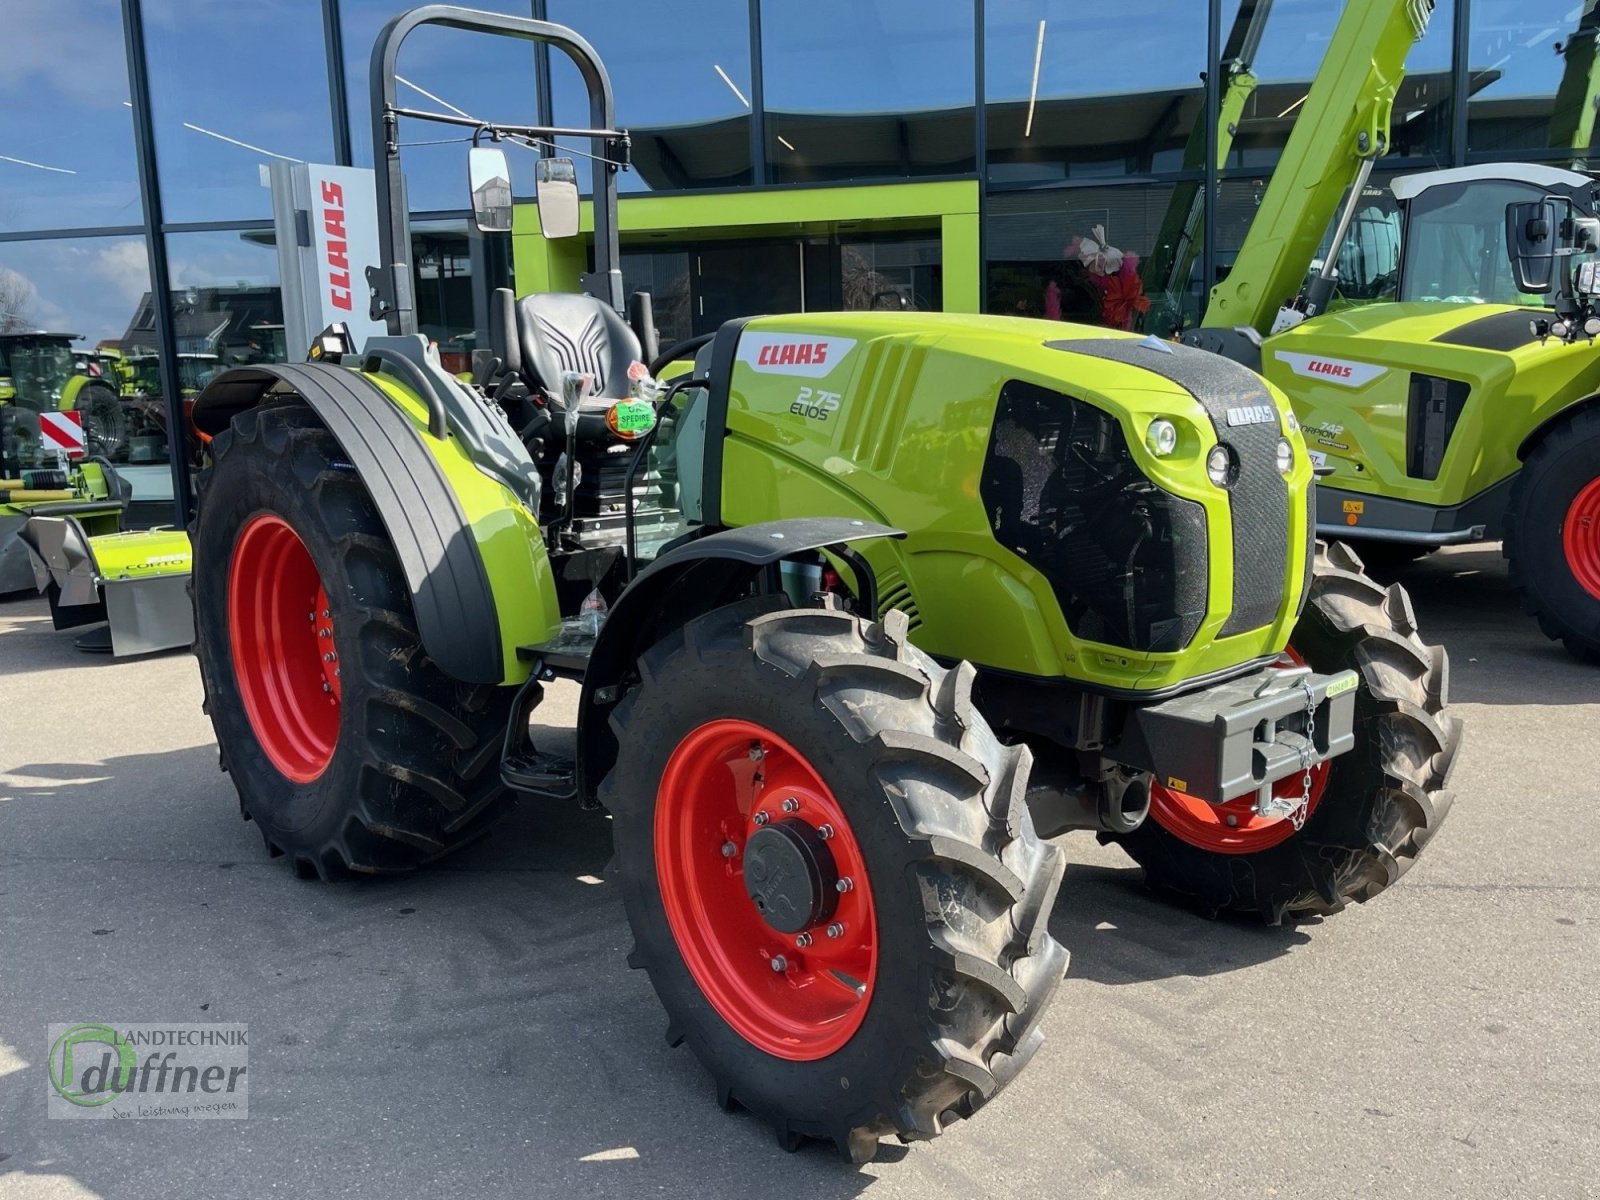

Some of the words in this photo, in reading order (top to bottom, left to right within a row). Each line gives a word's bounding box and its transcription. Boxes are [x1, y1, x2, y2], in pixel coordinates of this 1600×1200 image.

[321, 179, 353, 312] CLAAS
[758, 343, 828, 366] CLAAS
[1307, 360, 1353, 378] CLAAS
[796, 386, 842, 411] 2.75
[621, 414, 650, 424] SPEDIRE
[789, 402, 830, 421] ELIOS
[1227, 405, 1276, 427] CLAAS
[1300, 424, 1337, 440] ORPION
